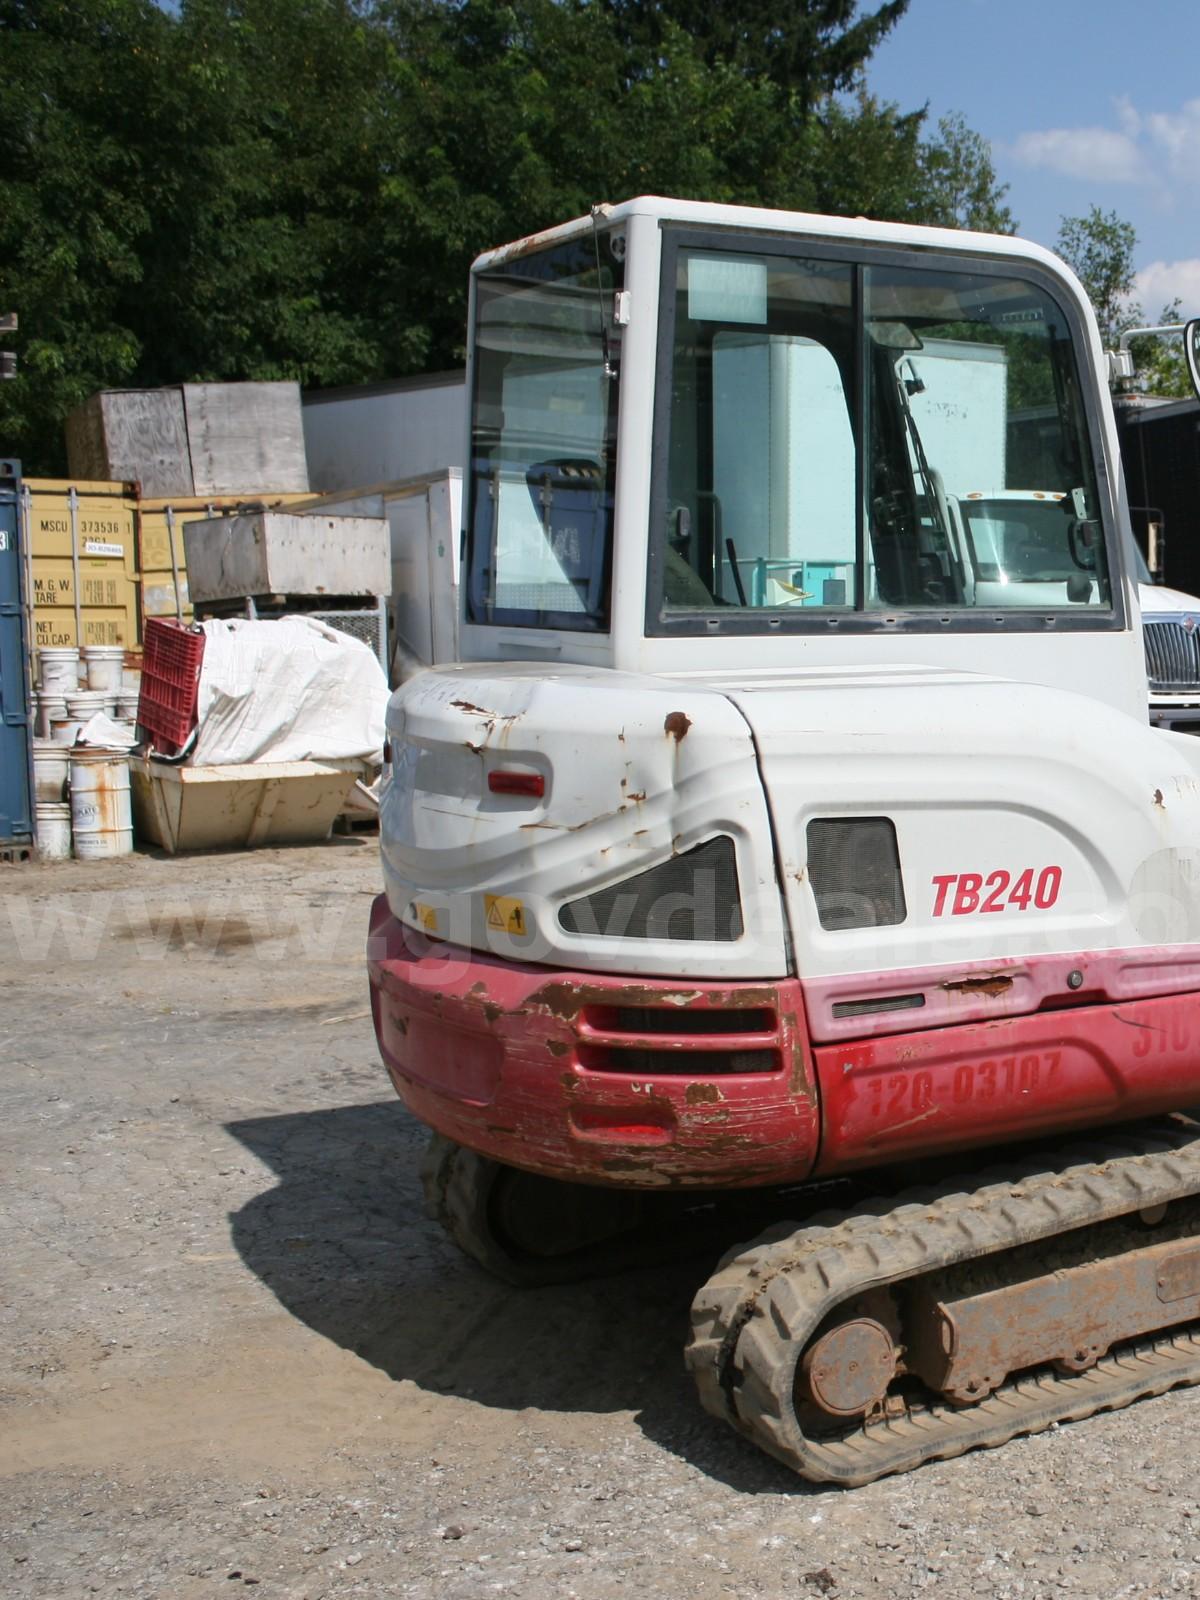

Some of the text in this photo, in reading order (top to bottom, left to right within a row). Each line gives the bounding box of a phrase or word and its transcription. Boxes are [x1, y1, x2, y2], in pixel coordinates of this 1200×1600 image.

[40, 520, 68, 533] MSCU
[81, 521, 119, 534] 373536
[35, 591, 57, 604] TARE
[36, 621, 53, 634] NET
[931, 865, 1063, 917] TB240
[867, 1052, 1064, 1117] 120-03107
